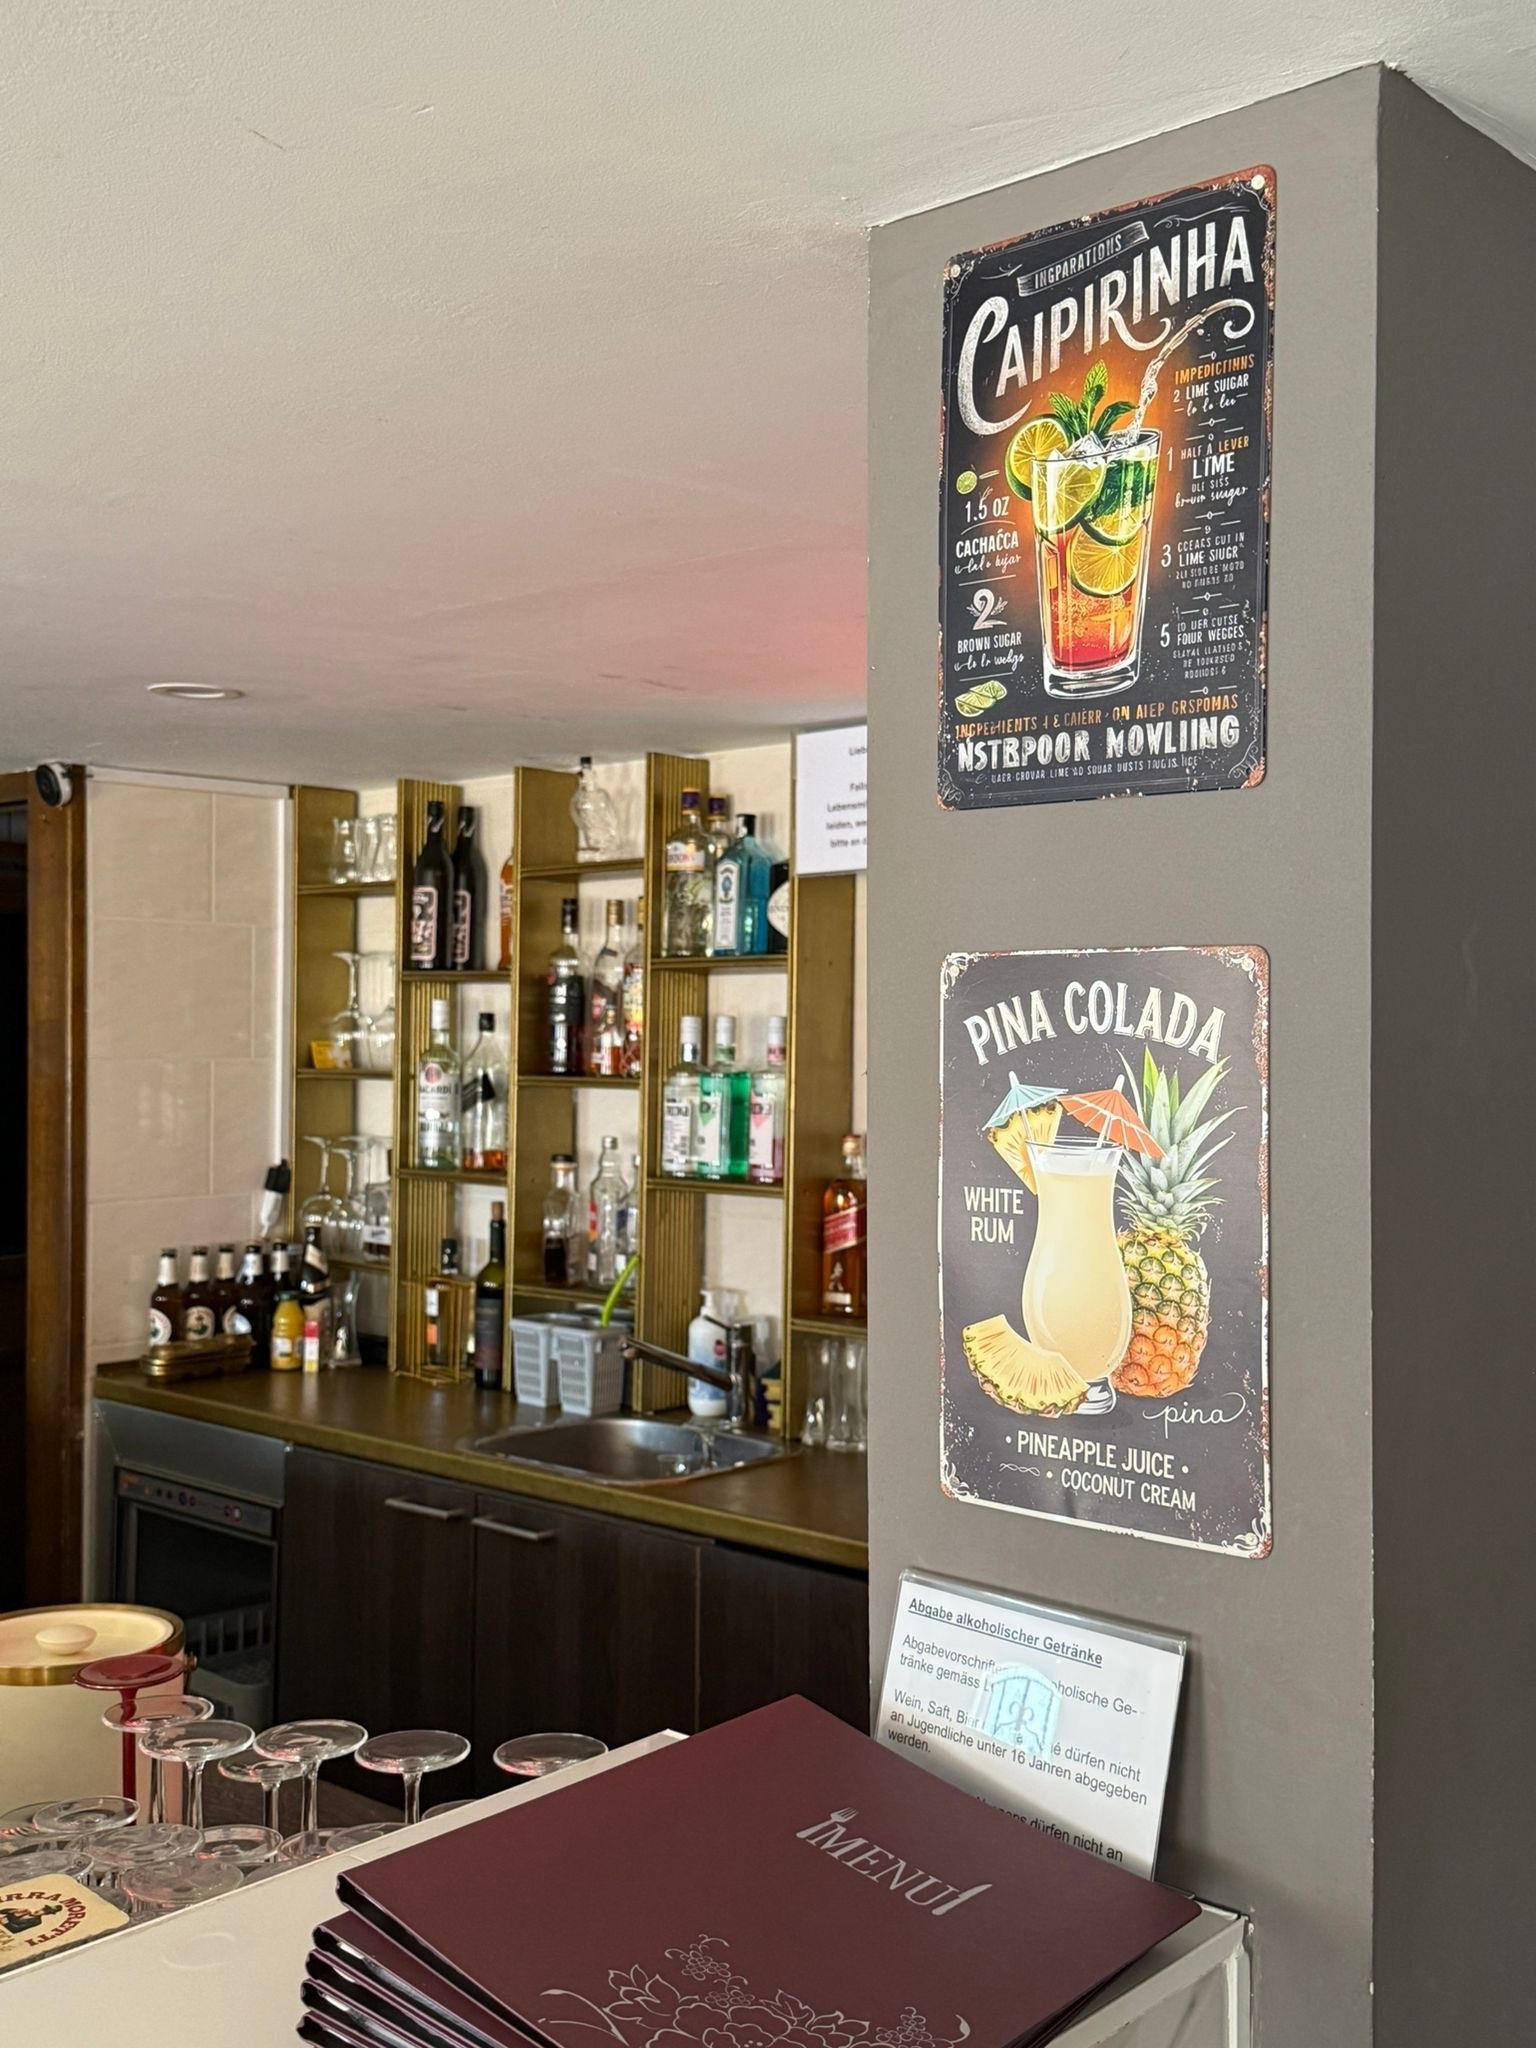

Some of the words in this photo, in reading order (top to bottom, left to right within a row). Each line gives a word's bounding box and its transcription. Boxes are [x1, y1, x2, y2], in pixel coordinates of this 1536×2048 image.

[957, 216, 1254, 436] CAIPIRINHA
[1173, 389, 1181, 403] 2
[1186, 383, 1209, 400] LIME
[1218, 435, 1249, 453] LEVER
[1193, 452, 1235, 479] LIME
[992, 495, 1010, 518] OZ
[1161, 544, 1172, 568] 3
[1179, 550, 1205, 567] LIME
[957, 636, 991, 654] BROWN
[993, 632, 1022, 649] SUGAR
[1160, 623, 1171, 648] 5
[963, 989, 1057, 1065] PINA
[1064, 980, 1226, 1065] COLADA
[963, 1186, 1024, 1215] WHITE
[971, 1216, 1015, 1244] RUM
[1143, 1392, 1246, 1439] pina
[1017, 1430, 1117, 1469] PINEAPPLE
[1122, 1447, 1175, 1479] JUICE
[1061, 1467, 1135, 1500] COCONUT
[1141, 1484, 1196, 1512] CREAM
[909, 1597, 953, 1621] Abgabe
[956, 1612, 1040, 1647] alkoholischer
[1043, 1635, 1103, 1665] Getränke
[900, 1653, 934, 1674] tränke
[936, 1665, 980, 1690] gemäss
[888, 1728, 931, 1753] werden.
[894, 1688, 924, 1712] Wein,
[927, 1700, 952, 1721] Saft,
[1065, 1744, 1105, 1771] dürfen
[1109, 1761, 1141, 1782] nicht
[890, 1709, 905, 1724] an
[907, 1714, 974, 1748] Jugendliche
[977, 1738, 1007, 1759] unter
[1011, 1748, 1026, 1765] 16
[1075, 1769, 1148, 1806] abgegeben
[1073, 1834, 1104, 1856] nicht
[1107, 1846, 1123, 1863] an
[806, 1823, 960, 1906] MENU
[25, 1897, 86, 1947] MORETTI
